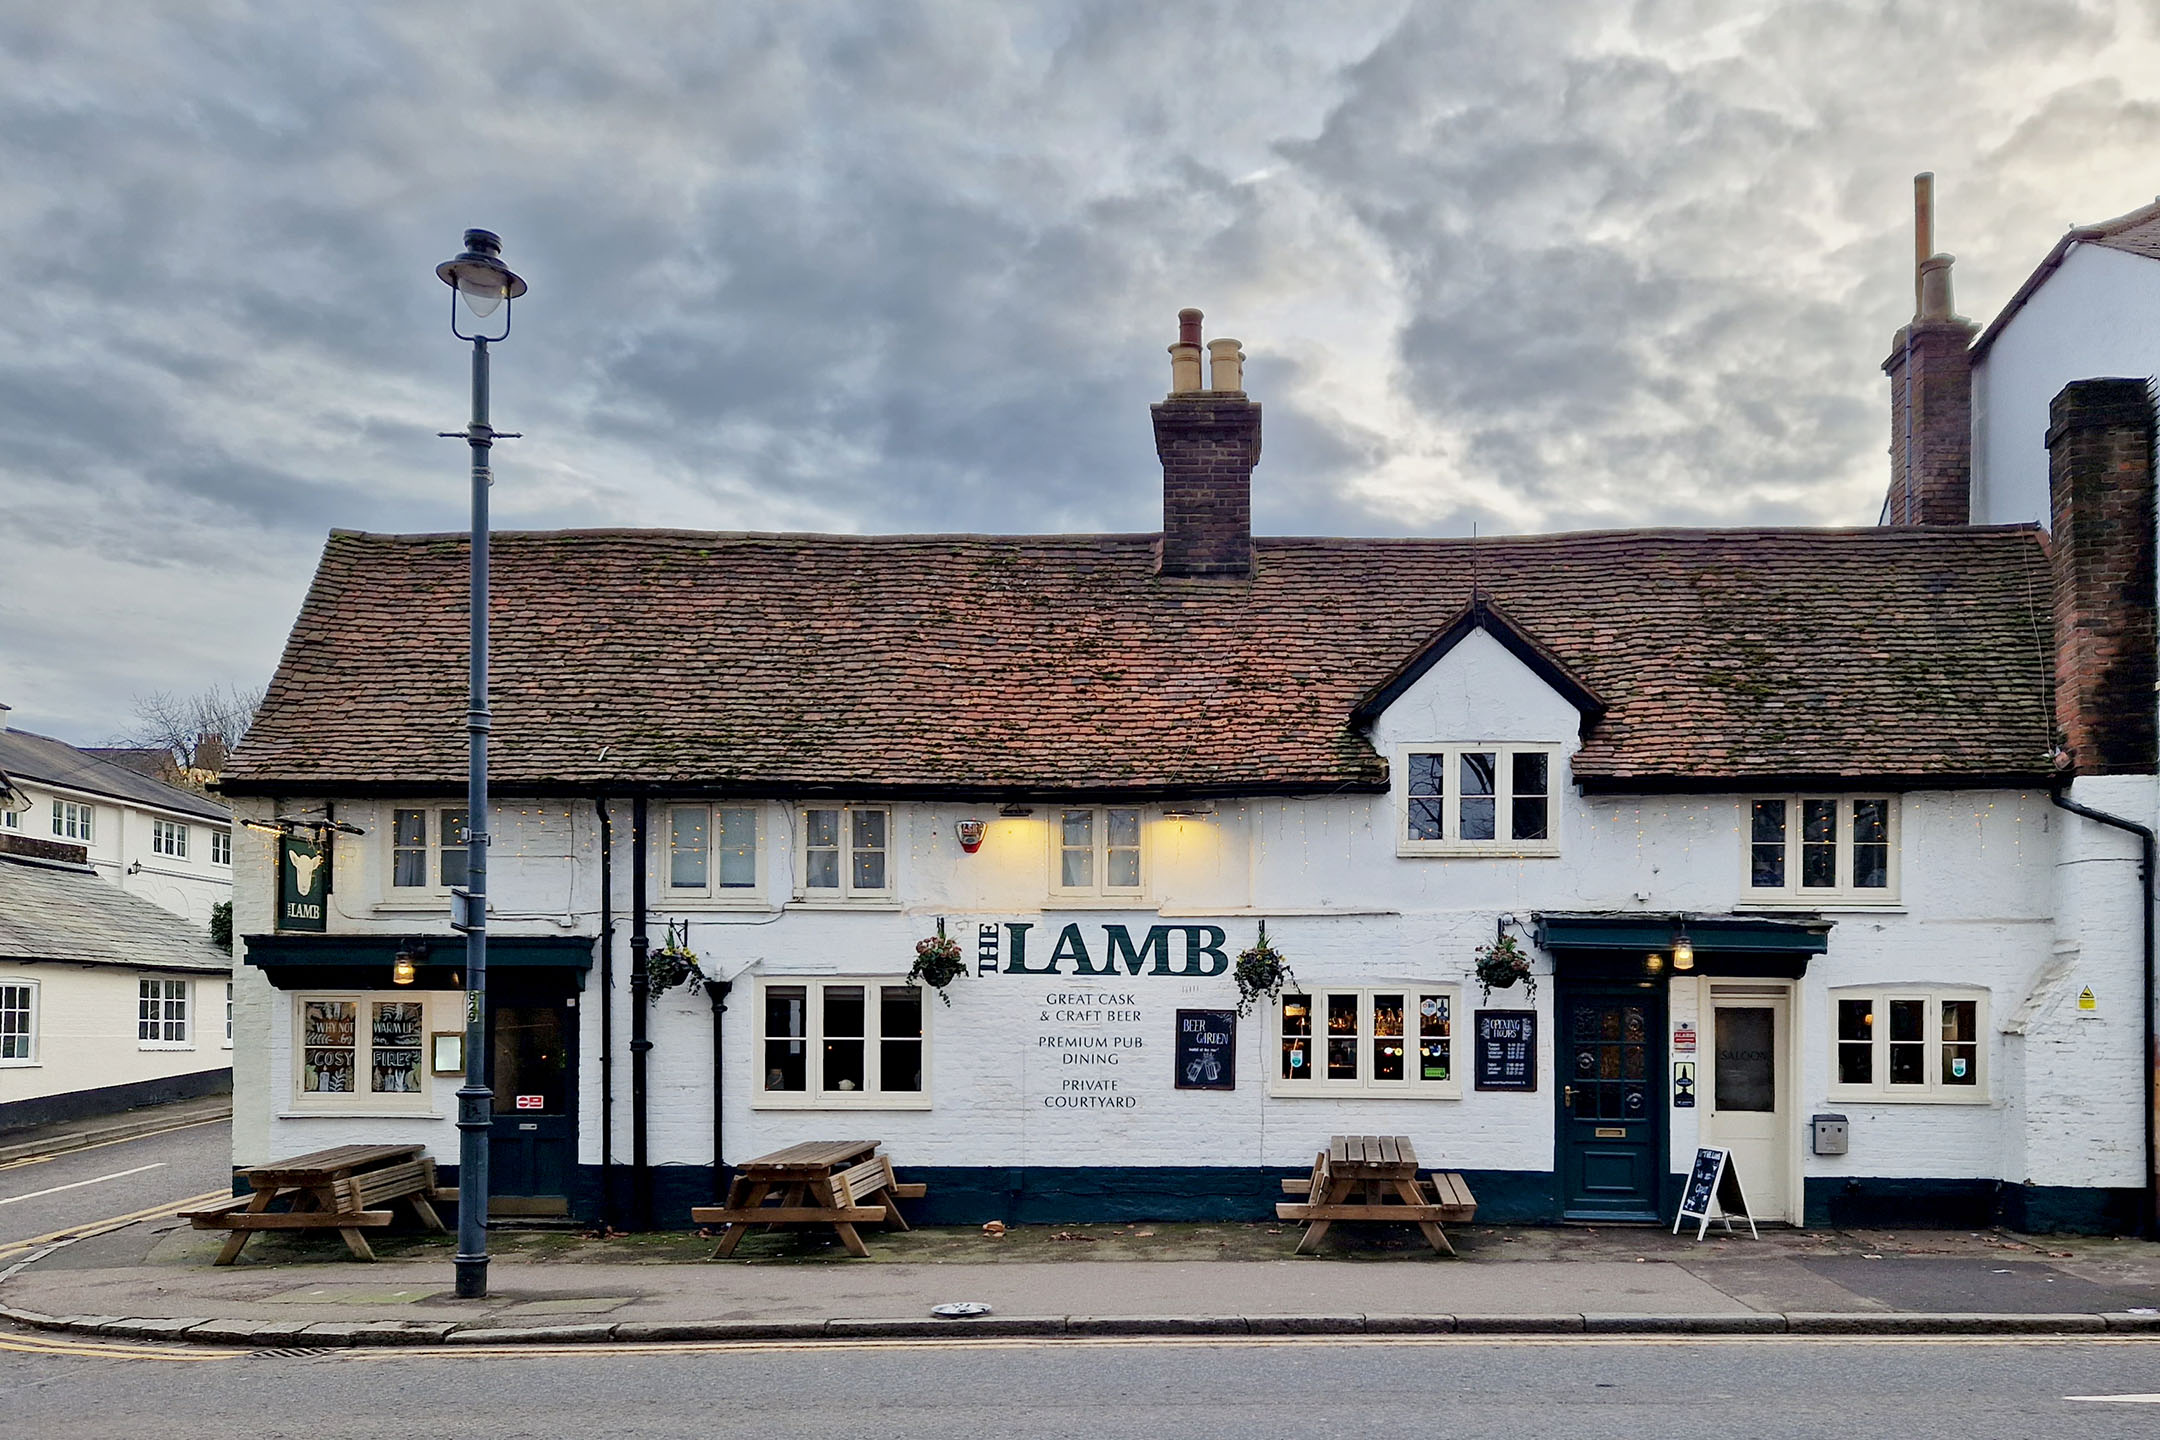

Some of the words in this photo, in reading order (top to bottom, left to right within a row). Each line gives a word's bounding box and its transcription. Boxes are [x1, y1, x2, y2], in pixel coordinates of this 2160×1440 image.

[291, 903, 320, 919] LAMB
[978, 923, 999, 978] THE
[1003, 922, 1229, 977] LAMB
[1046, 993, 1092, 1005] GREAT
[1098, 993, 1136, 1005] CASK
[468, 991, 477, 1022] 629
[1040, 1011, 1050, 1022] &
[1056, 1010, 1101, 1022] CRAFT
[1107, 1010, 1142, 1022] BEER
[316, 1022, 338, 1033] WHY
[339, 1022, 354, 1033] NOT
[373, 1022, 401, 1033] WARM
[402, 1022, 414, 1033] UP
[1183, 1018, 1206, 1032] BEER
[1490, 1019, 1520, 1031] OPENING
[1196, 1032, 1229, 1045] GARDEN
[1493, 1029, 1517, 1038] HOURS
[1039, 1036, 1107, 1048] PREMIUM
[1114, 1036, 1143, 1048] PUB
[314, 1051, 354, 1066] COSY
[373, 1051, 412, 1067] FIRE?
[1062, 1053, 1119, 1065] DINING
[1721, 1050, 1769, 1060] SALOON
[1062, 1079, 1118, 1091] PRIVATE
[1044, 1096, 1136, 1108] COURTYARD
